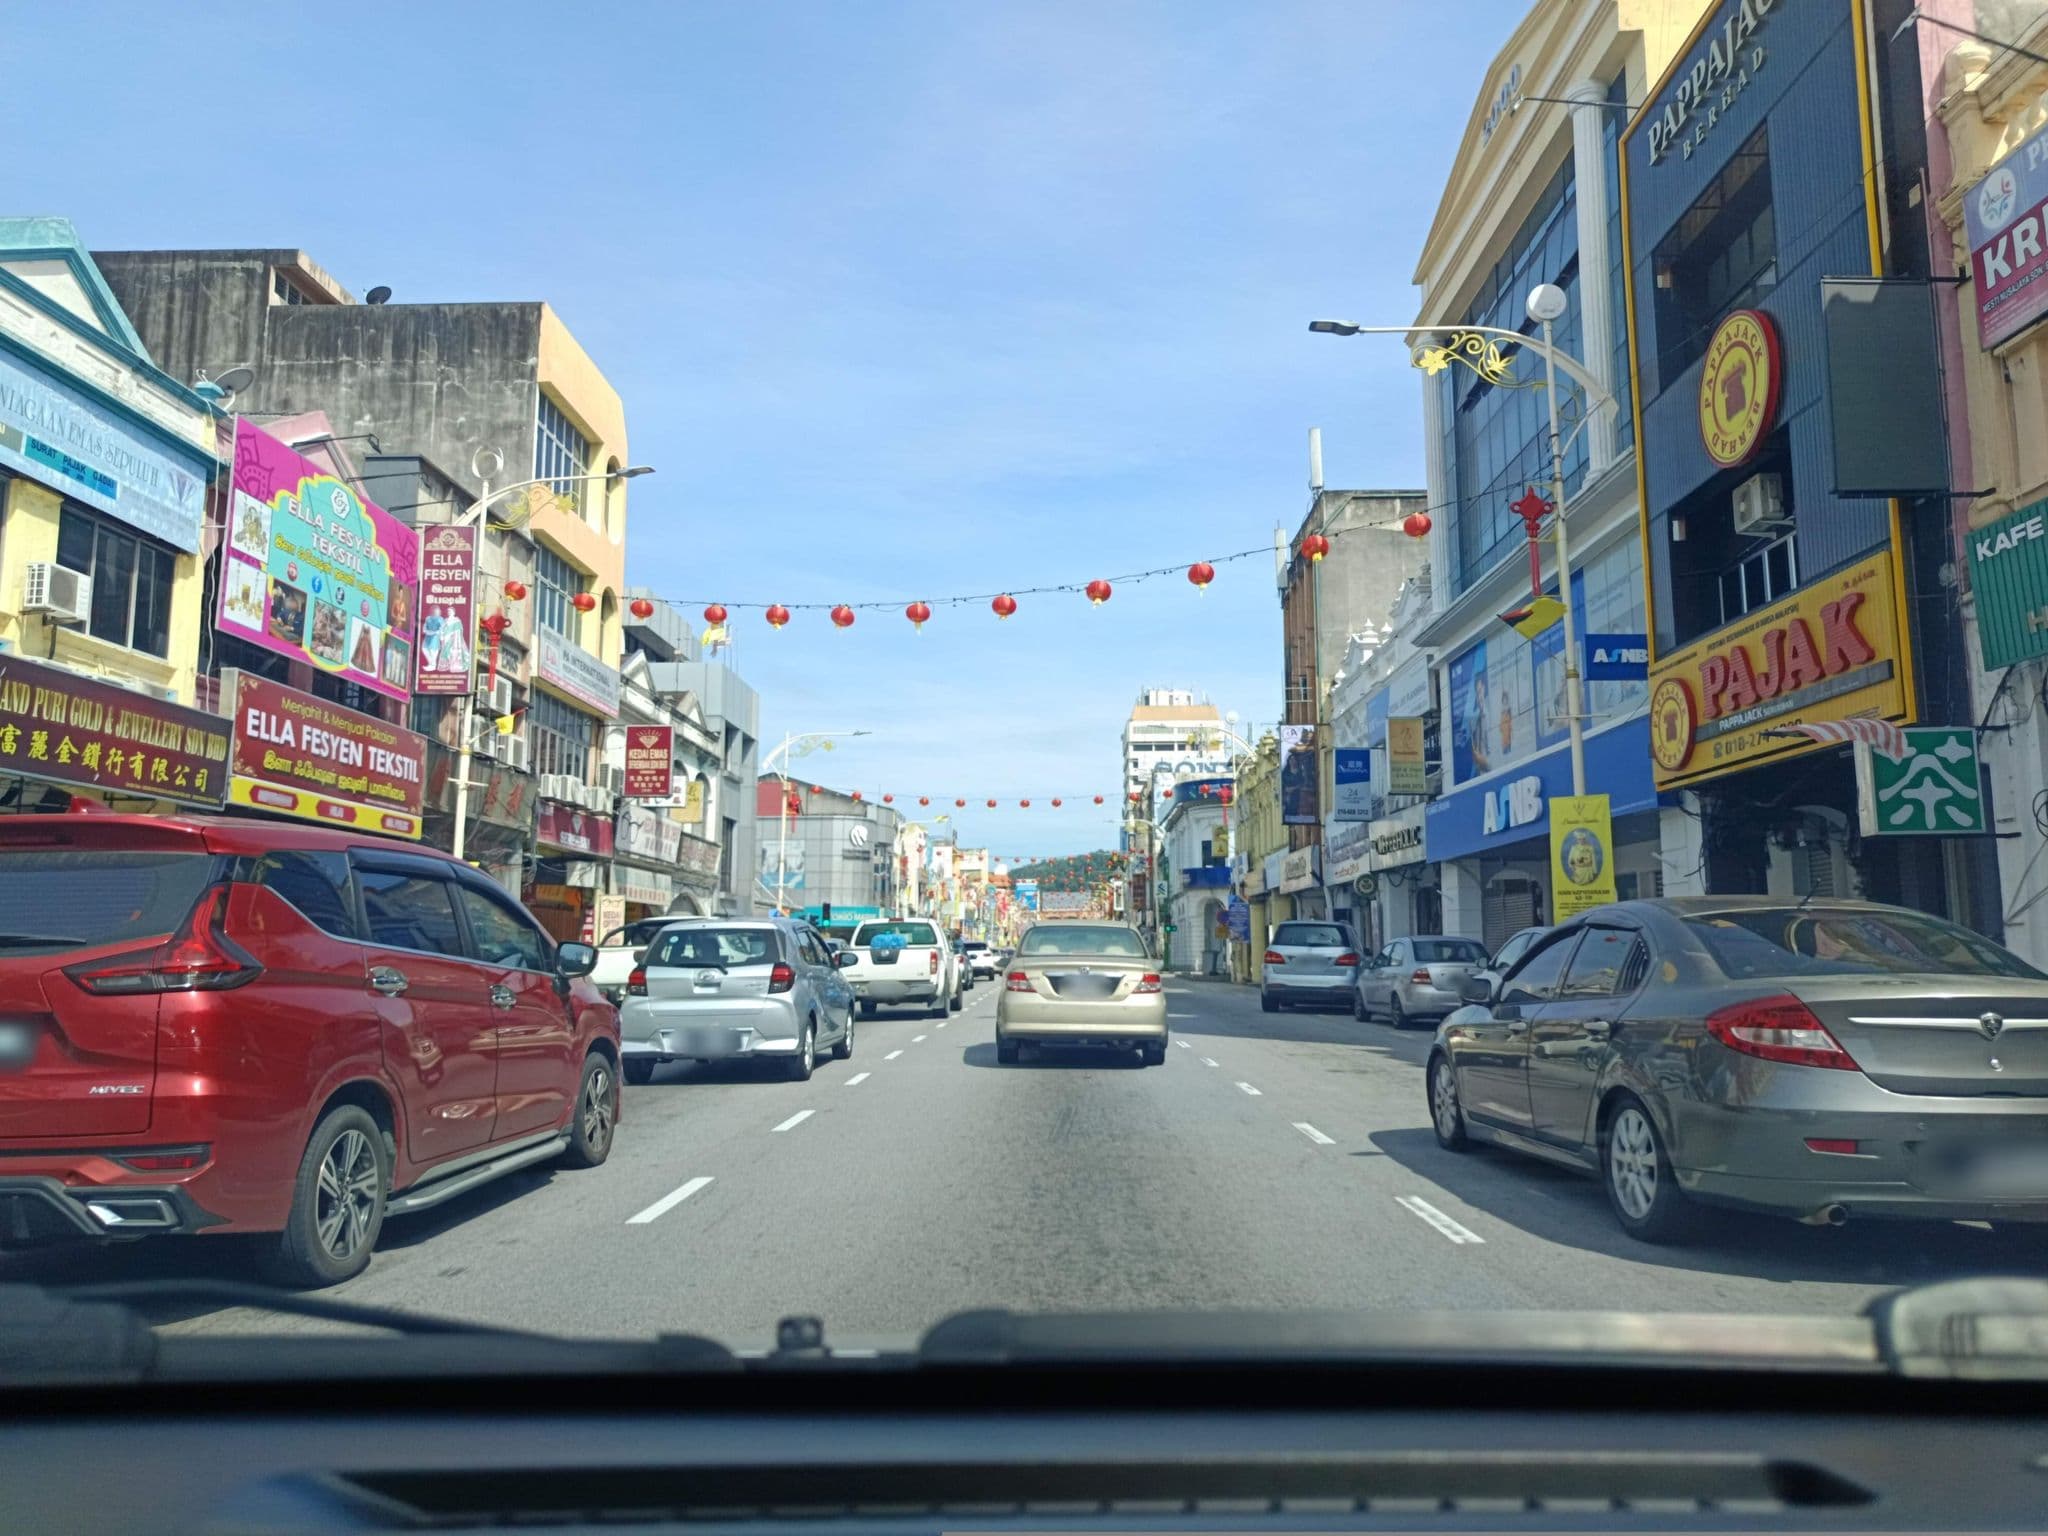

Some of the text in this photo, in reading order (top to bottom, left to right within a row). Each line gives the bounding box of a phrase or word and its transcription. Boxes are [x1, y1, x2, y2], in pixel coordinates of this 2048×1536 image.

[1683, 47, 1763, 160] BERHAD
[1704, 324, 1763, 409] PAPPAJACK
[30, 438, 57, 460] SURAT
[62, 455, 87, 475] PAJAK
[69, 421, 103, 457] EMAS
[105, 444, 160, 488] SEPULUH
[288, 497, 381, 564] ELLA FESYEN
[311, 532, 363, 574] TEKSTIL
[1976, 515, 2045, 562] KAFE
[424, 568, 471, 581] FESYEN
[432, 554, 464, 566] ELLA
[1593, 648, 1648, 663] ASNB
[1699, 592, 1876, 720] PAJAK
[32, 687, 68, 724] PURI
[70, 697, 104, 735] GOLD
[104, 705, 114, 735] &
[115, 709, 185, 752] JEWELLERY
[185, 727, 206, 758] SDN
[206, 733, 228, 762] BHD
[282, 697, 322, 720] Menjahit
[331, 714, 364, 735] Menjual
[1719, 706, 1762, 731] PAPPAJACK
[246, 707, 420, 783] ELLA FESYEN TEKSTIL
[628, 749, 668, 760] KEDAI EMAS
[1483, 775, 1543, 835] ASNB
[1878, 735, 1977, 829] 茶
[89, 1085, 145, 1095] MIVEC
